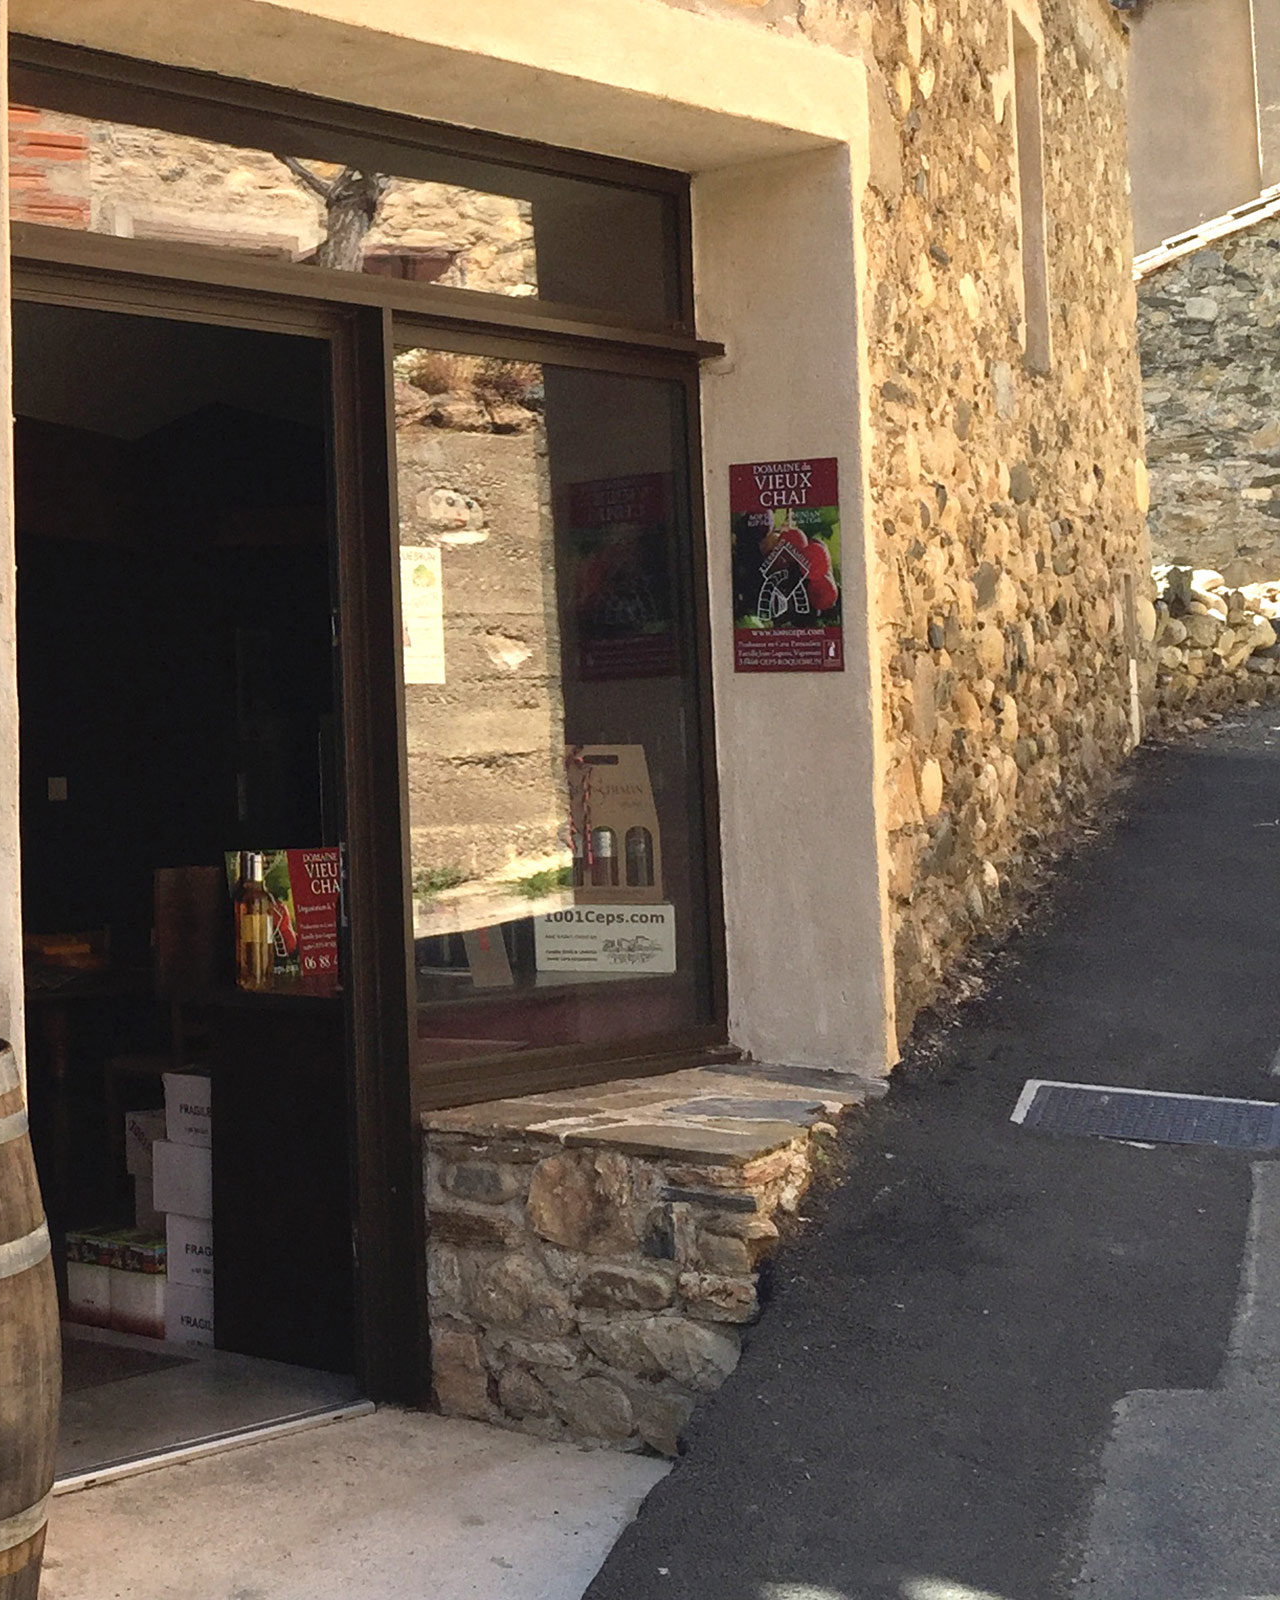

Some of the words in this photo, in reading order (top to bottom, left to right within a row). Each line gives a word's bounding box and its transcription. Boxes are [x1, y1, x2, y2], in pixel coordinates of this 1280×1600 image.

[753, 463, 801, 475] DOMAINE
[754, 472, 812, 490] VIEUX
[759, 489, 807, 507] CHAI
[304, 862, 338, 878] VIEU
[311, 878, 341, 895] CHA
[544, 910, 665, 926] 1001Ceps.com
[185, 1243, 213, 1257] FRAG
[180, 1315, 213, 1331] FRAGIL
